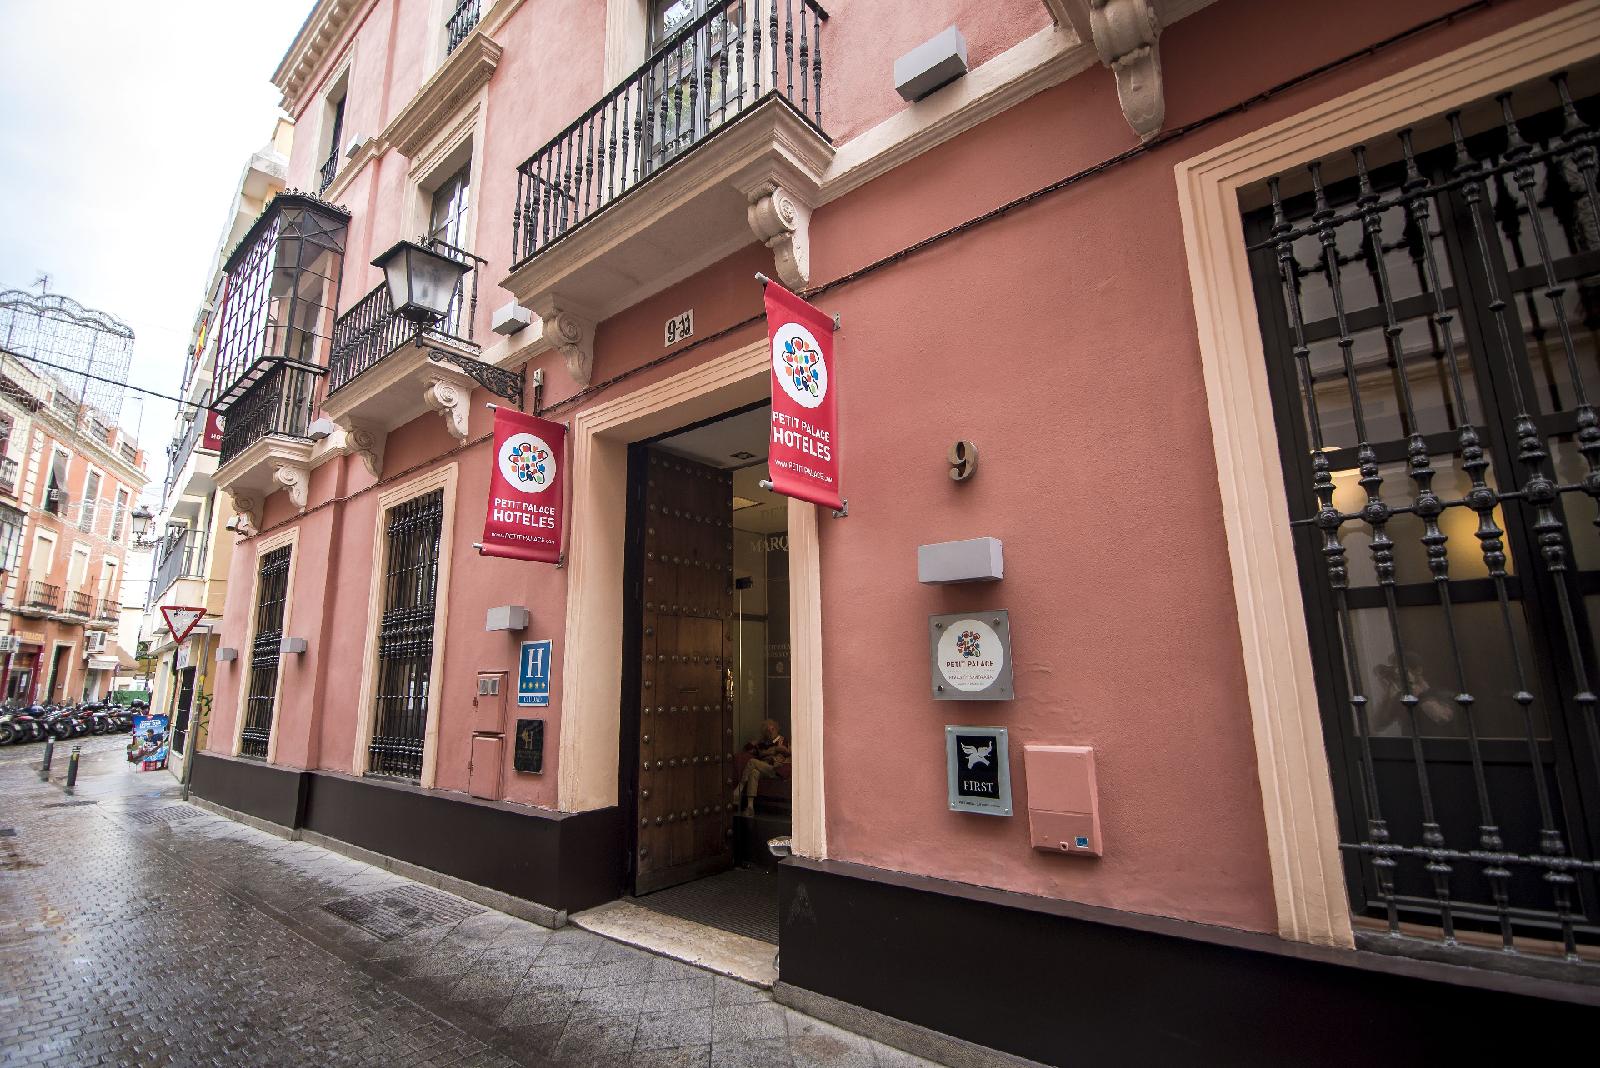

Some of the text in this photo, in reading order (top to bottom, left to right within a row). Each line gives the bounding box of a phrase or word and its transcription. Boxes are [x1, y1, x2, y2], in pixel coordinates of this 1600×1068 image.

[772, 411, 830, 442] PETIT PALACE
[773, 426, 831, 461] HOTELES
[947, 439, 979, 482] 9
[493, 509, 555, 529] HOTELES
[494, 498, 555, 515] PETIT PALACE
[525, 647, 545, 678] H
[946, 660, 965, 668] PETIT
[963, 780, 994, 793] FIRST
